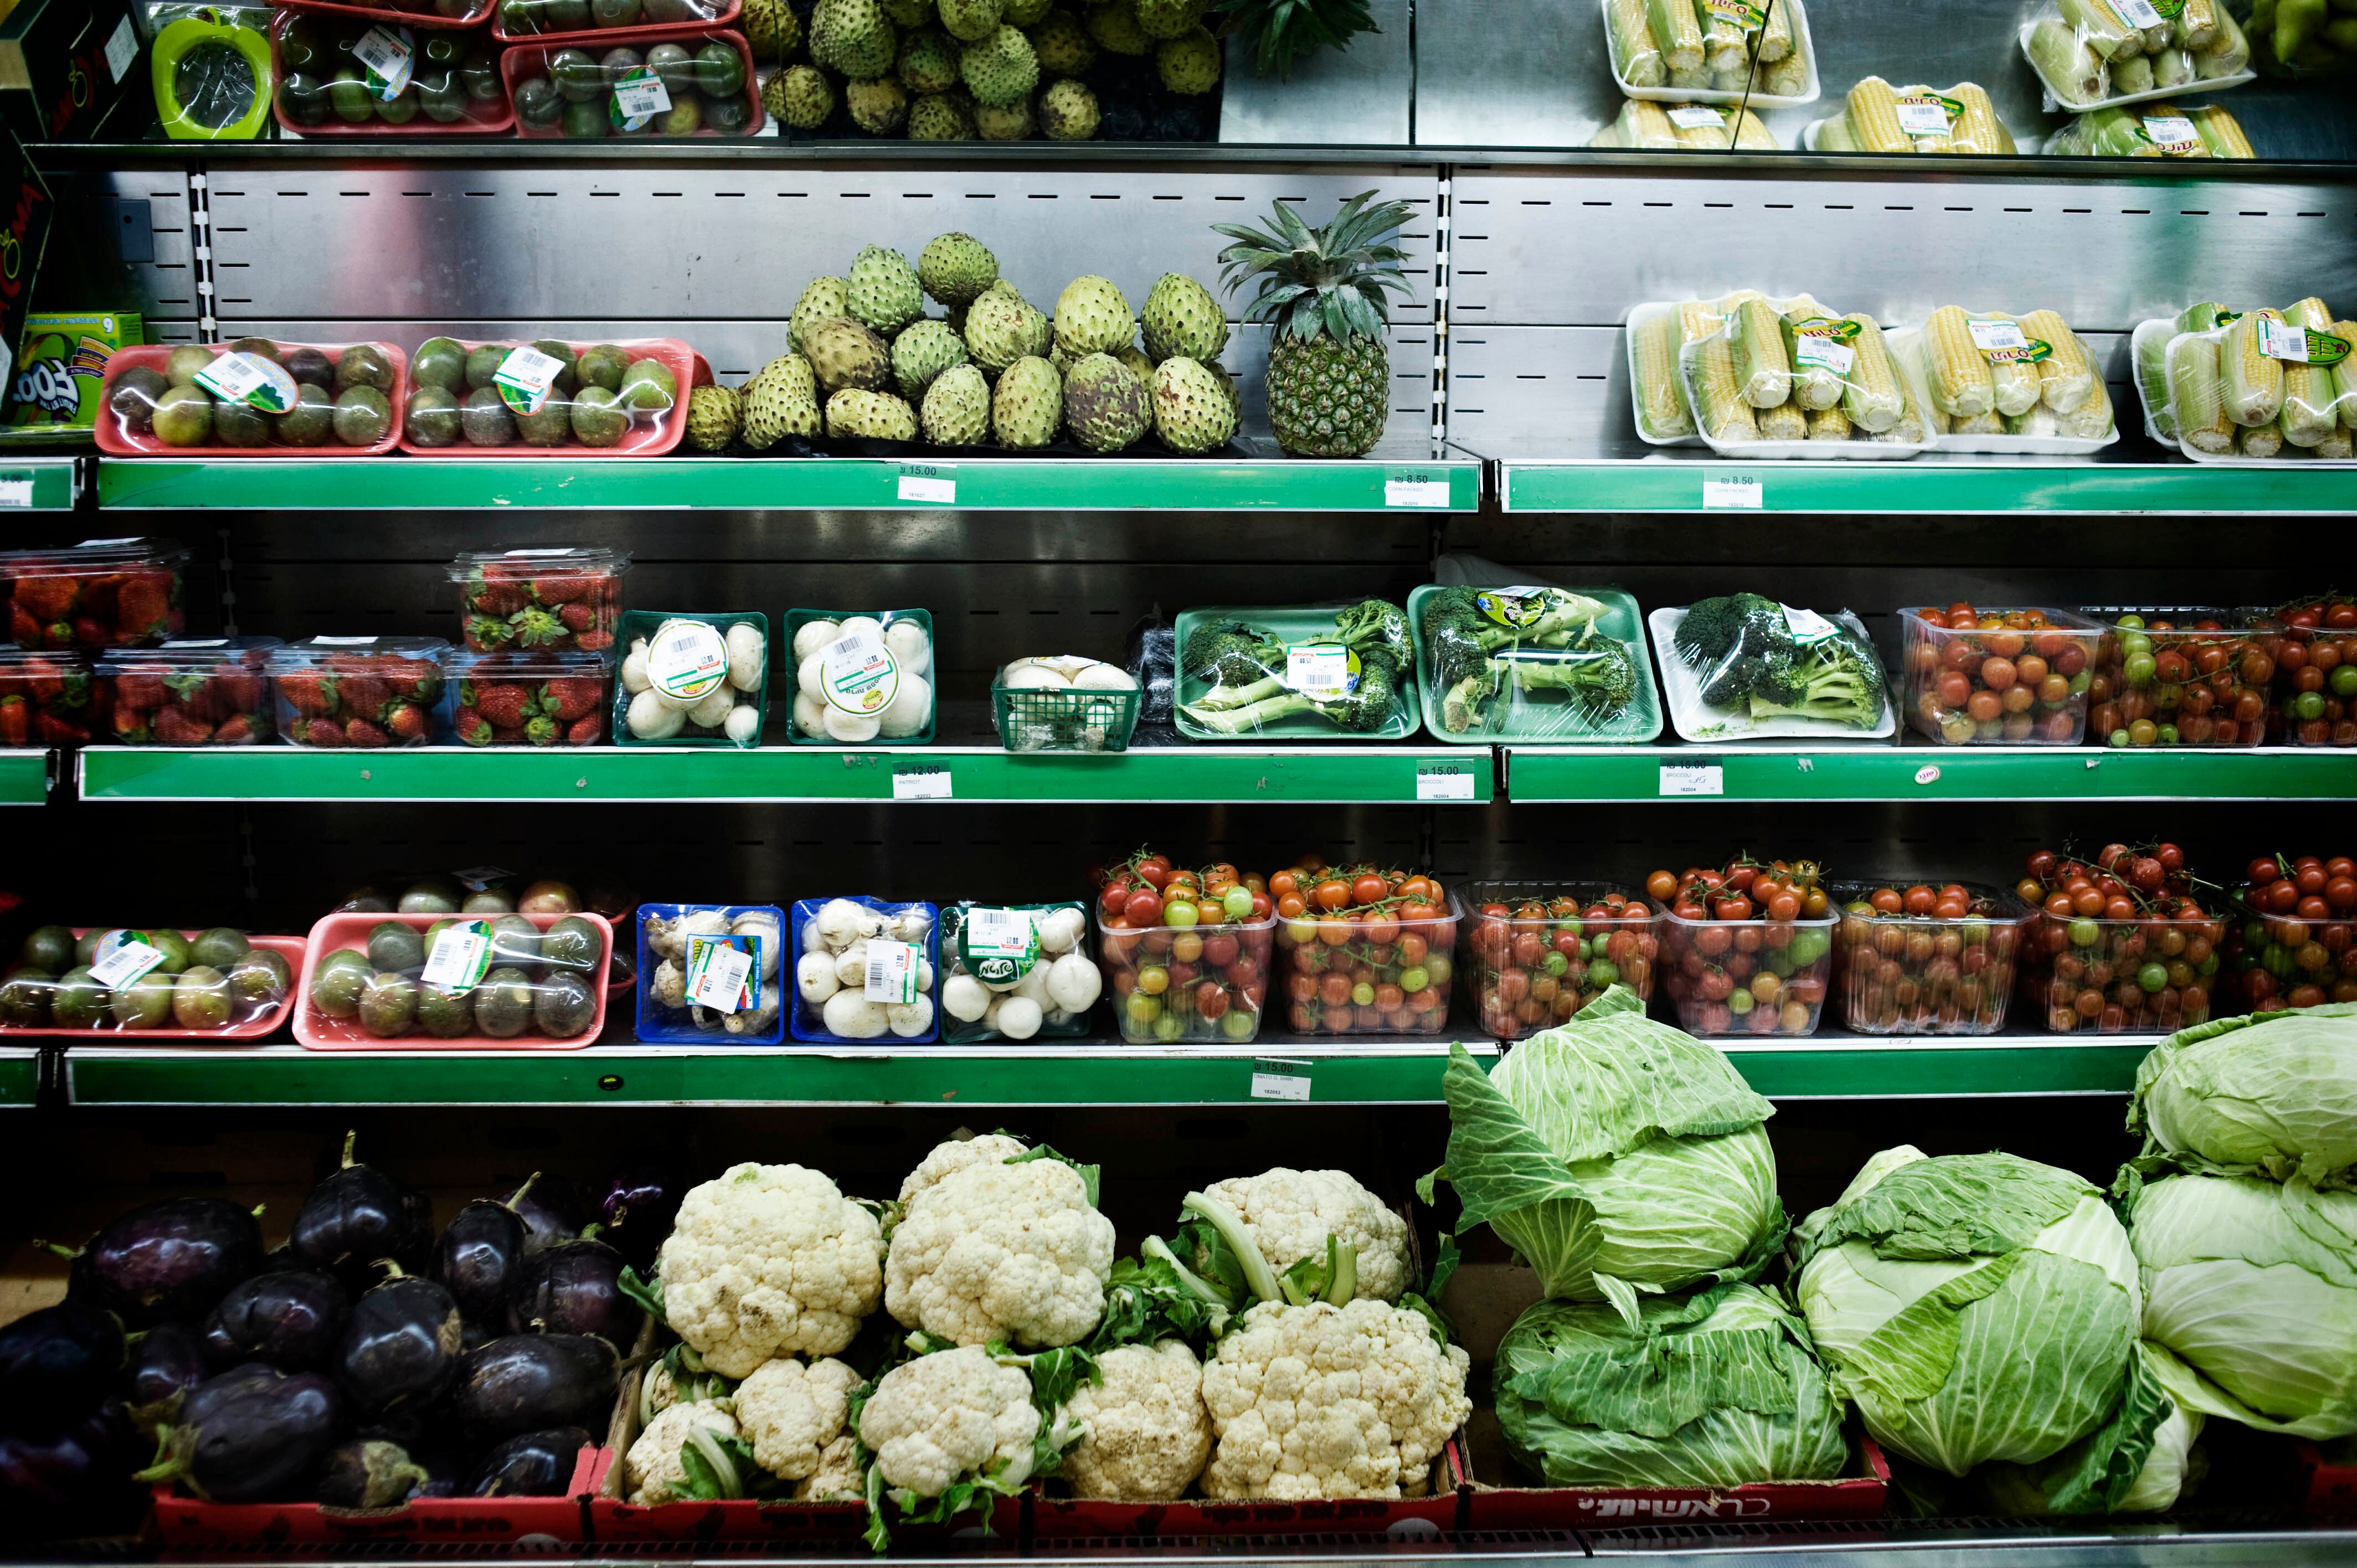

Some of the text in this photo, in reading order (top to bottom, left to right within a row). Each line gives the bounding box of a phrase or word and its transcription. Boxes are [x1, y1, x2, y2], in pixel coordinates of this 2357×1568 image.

[1990, 350, 2029, 361] תירס
[50, 399, 59, 411] BY
[58, 398, 77, 415] FRUIT
[909, 466, 936, 476] 15.00
[1407, 474, 1428, 483] 8.50
[1732, 476, 1753, 485] 8.50
[1680, 760, 1706, 769] 15.00
[911, 765, 940, 775] 12.00
[1431, 766, 1459, 775] 15.00
[1265, 1062, 1294, 1073] 15.00
